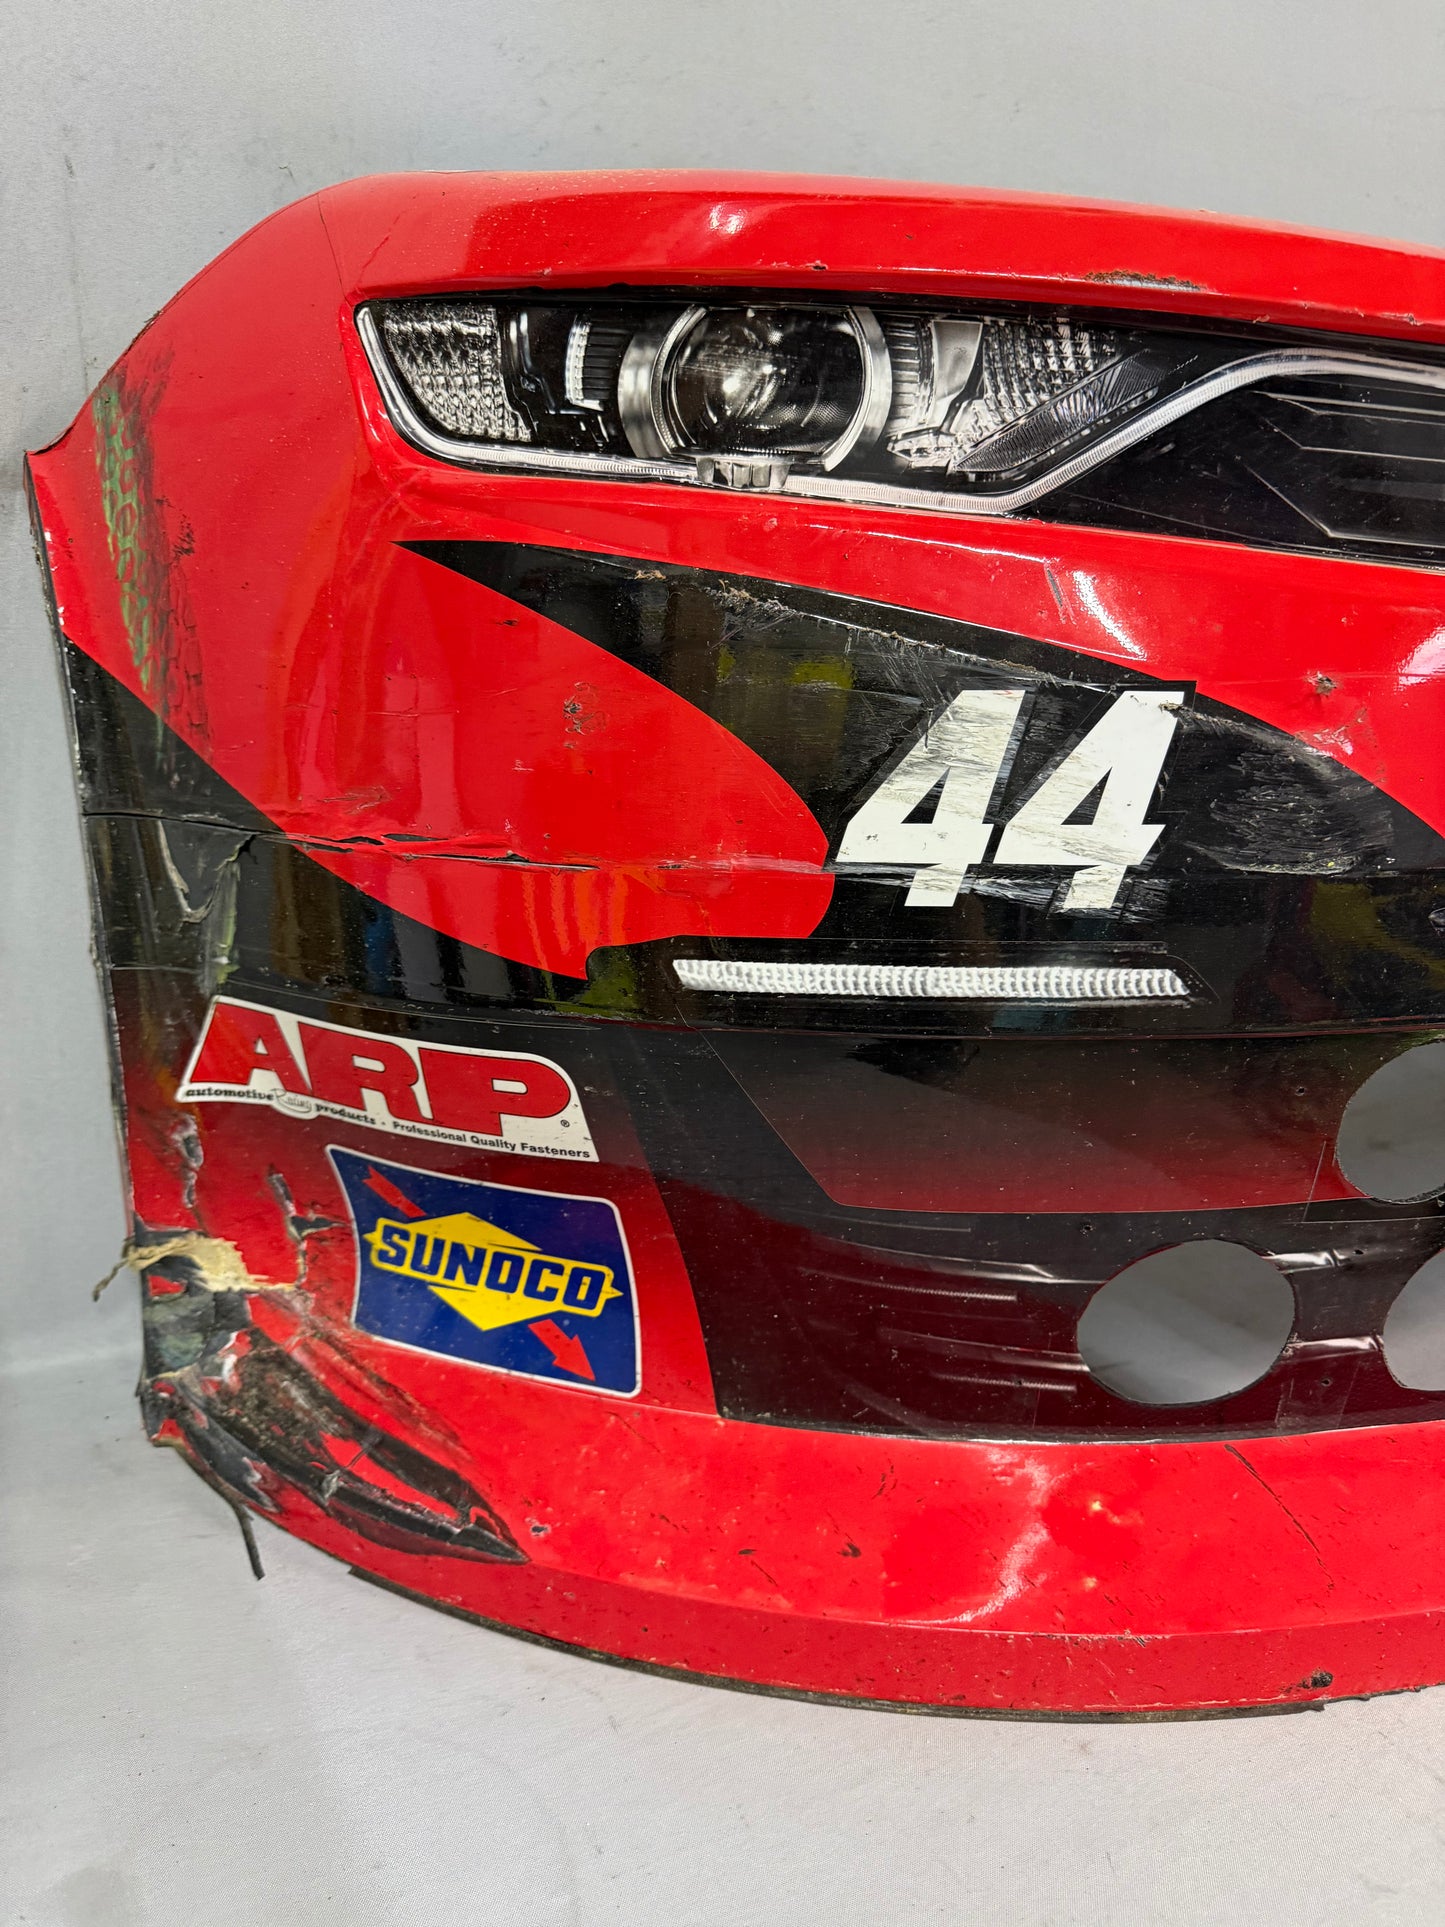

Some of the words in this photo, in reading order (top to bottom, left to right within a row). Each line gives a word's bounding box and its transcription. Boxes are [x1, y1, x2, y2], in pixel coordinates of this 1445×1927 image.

[836, 690, 1185, 909] 44
[185, 1087, 275, 1101] automotive
[315, 1102, 377, 1126] products
[392, 1121, 468, 1144] Professional
[470, 1134, 517, 1152] Quality
[520, 1142, 591, 1159] Fasteners
[189, 1002, 572, 1137] ARP
[376, 1223, 606, 1311] SUNOCO
